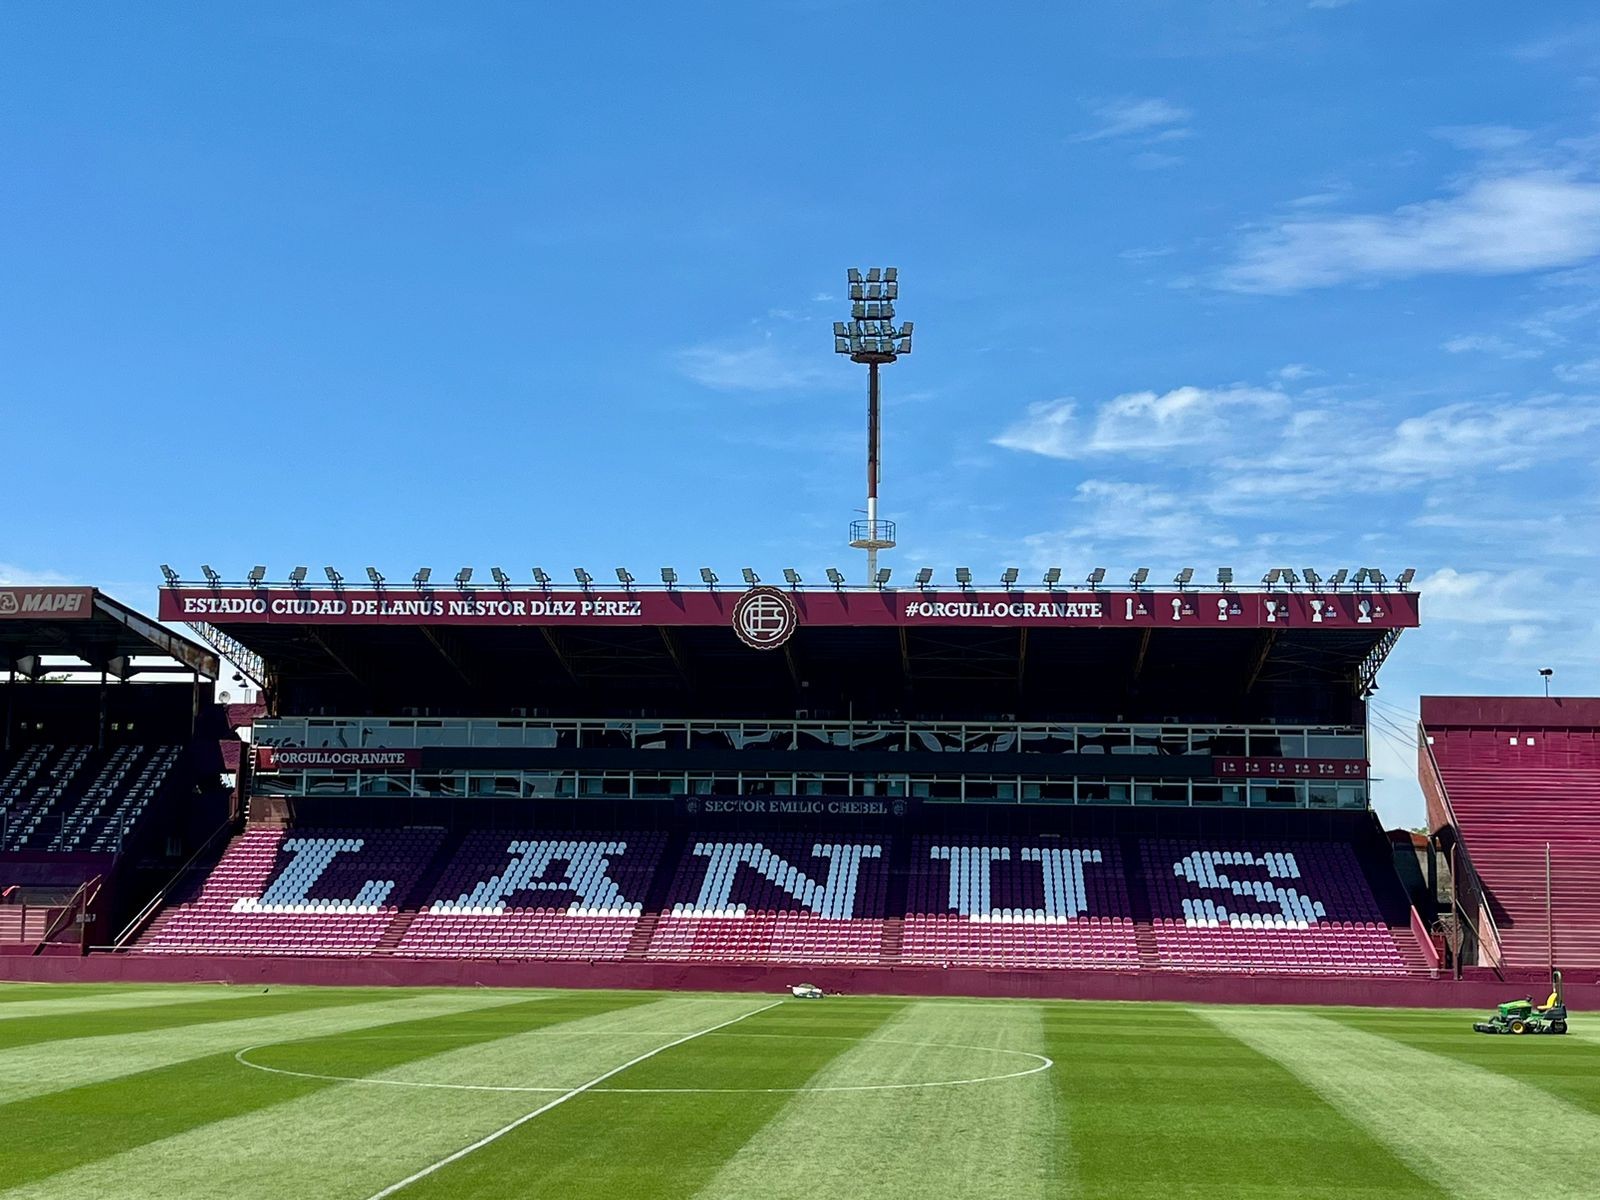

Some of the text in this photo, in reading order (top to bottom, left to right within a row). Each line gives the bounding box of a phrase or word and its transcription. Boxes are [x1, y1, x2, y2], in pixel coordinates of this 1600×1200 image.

[21, 593, 83, 612] MAPEI
[183, 595, 642, 617] ESTADIO CIUDAD DE LANÚS NÉSTOR DÍAZ PÉREZ
[905, 601, 1103, 618] #ORGULLOGRANATE
[270, 751, 405, 765] #ORGULLOGRANATE
[705, 800, 888, 814] SECTOR EMILIO CHEBEL
